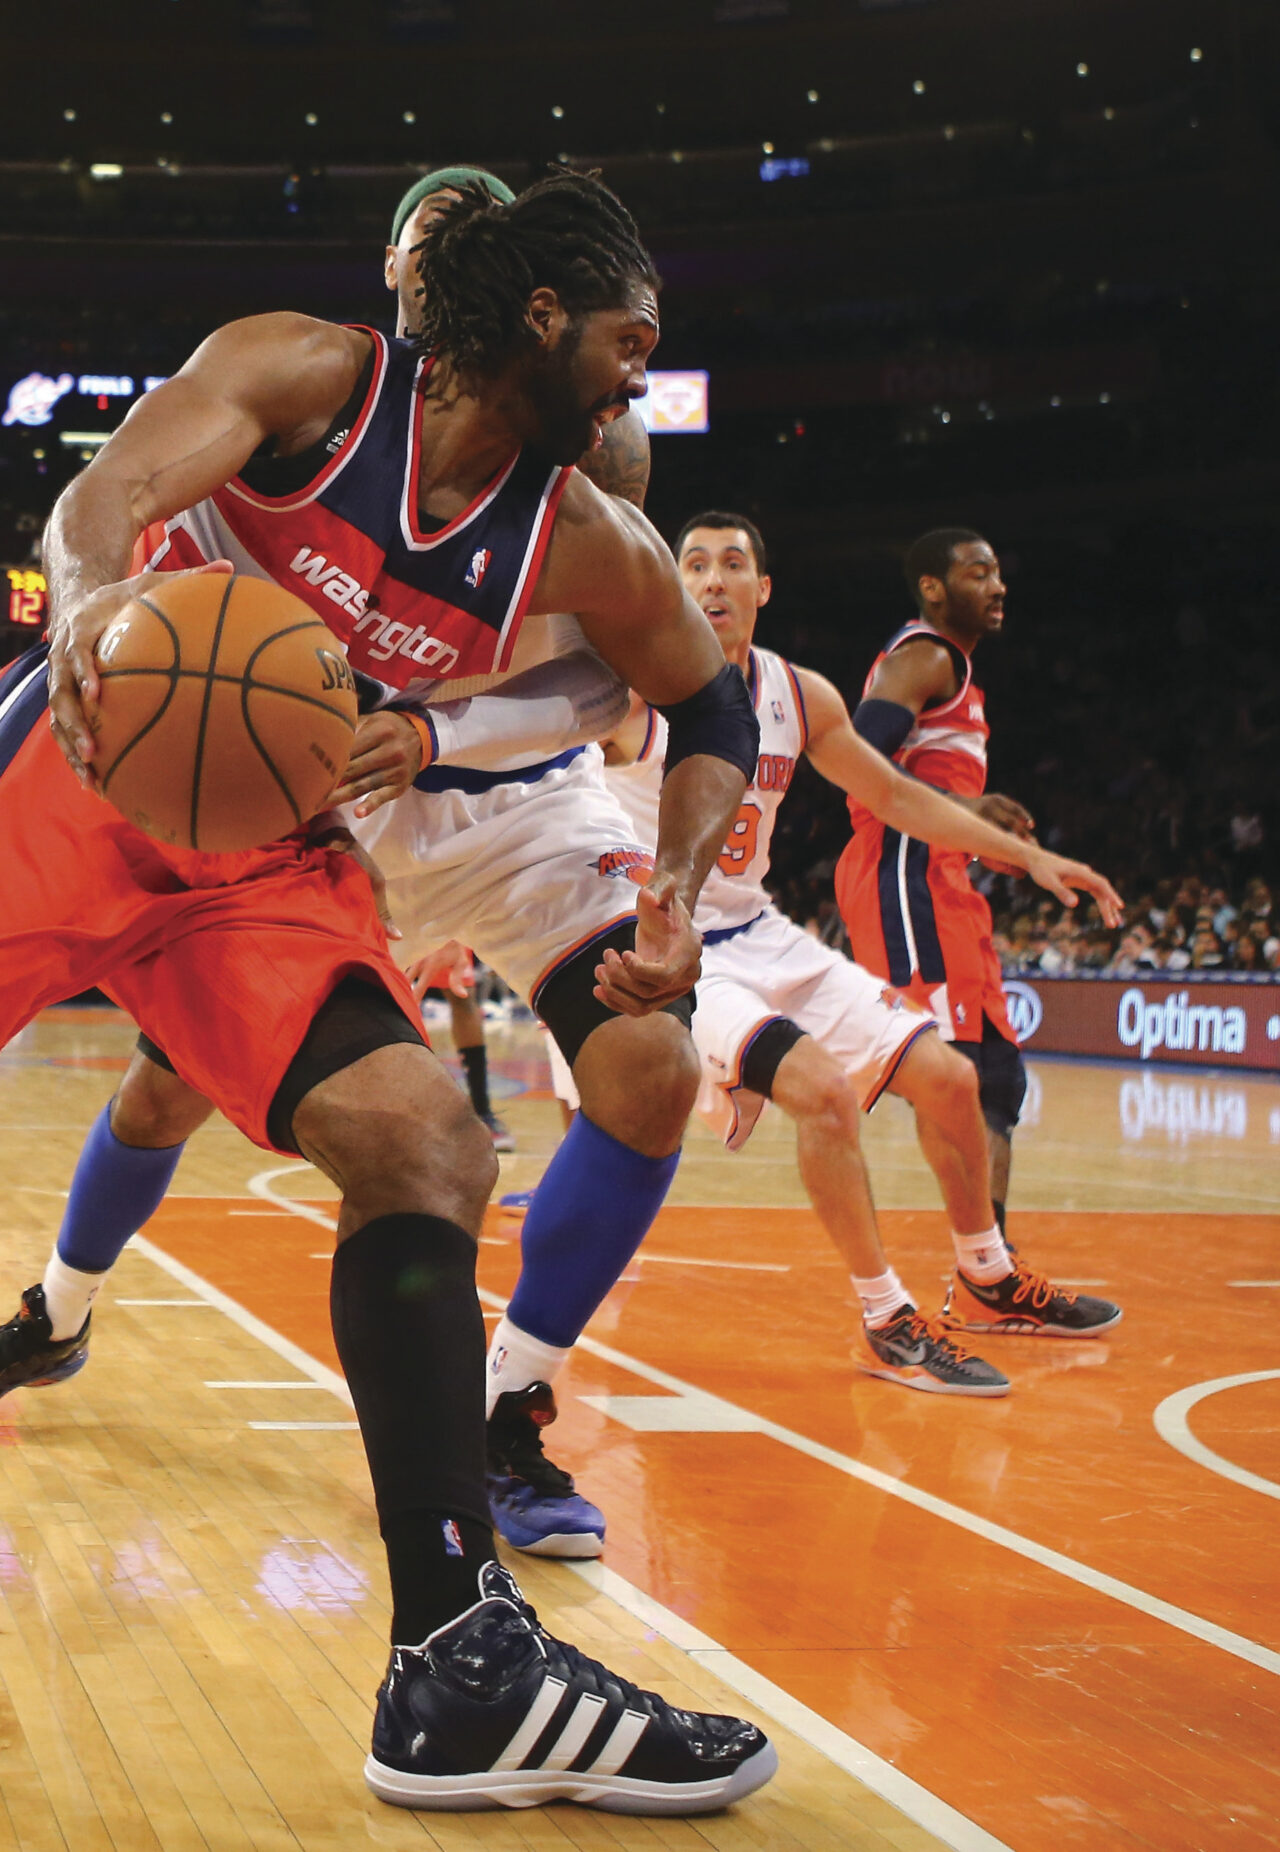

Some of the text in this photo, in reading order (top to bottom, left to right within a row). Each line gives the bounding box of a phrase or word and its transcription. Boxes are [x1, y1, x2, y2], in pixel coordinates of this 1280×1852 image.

[78, 374, 134, 396] FOULS
[9, 590, 44, 625] 12
[1117, 987, 1247, 1060] Optima
